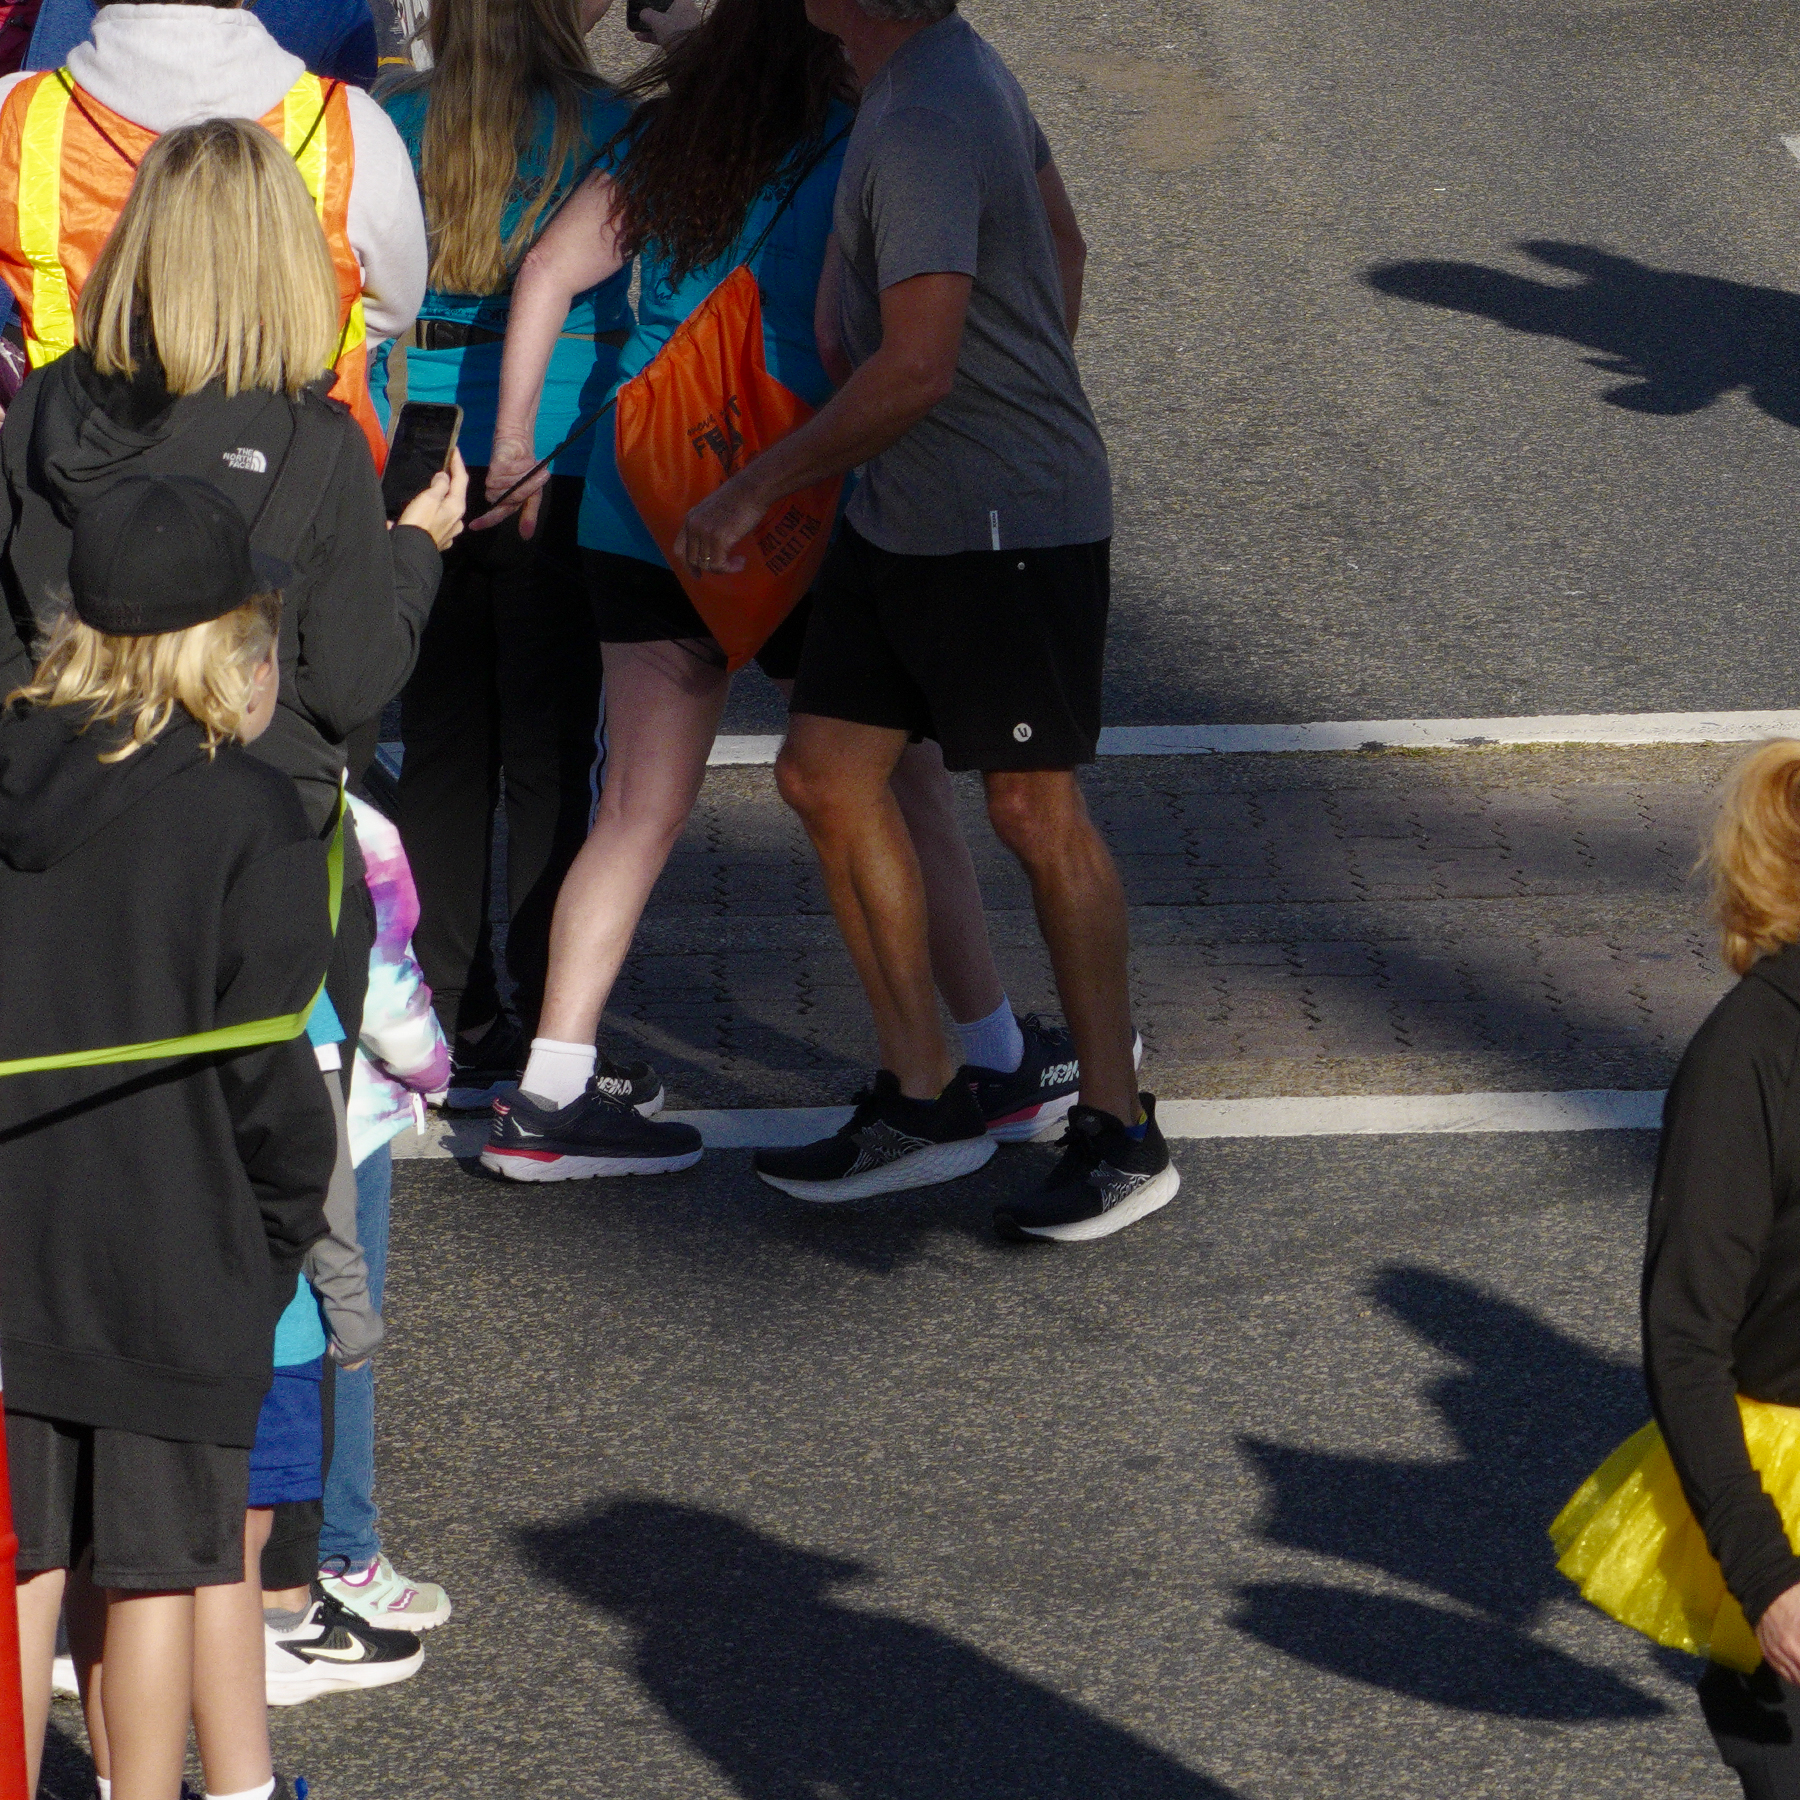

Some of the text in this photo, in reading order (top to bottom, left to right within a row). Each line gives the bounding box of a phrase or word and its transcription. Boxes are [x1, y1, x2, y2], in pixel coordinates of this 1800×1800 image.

[236, 447, 254, 455] THE
[222, 451, 255, 462] NORTH
[229, 459, 252, 468] FACE
